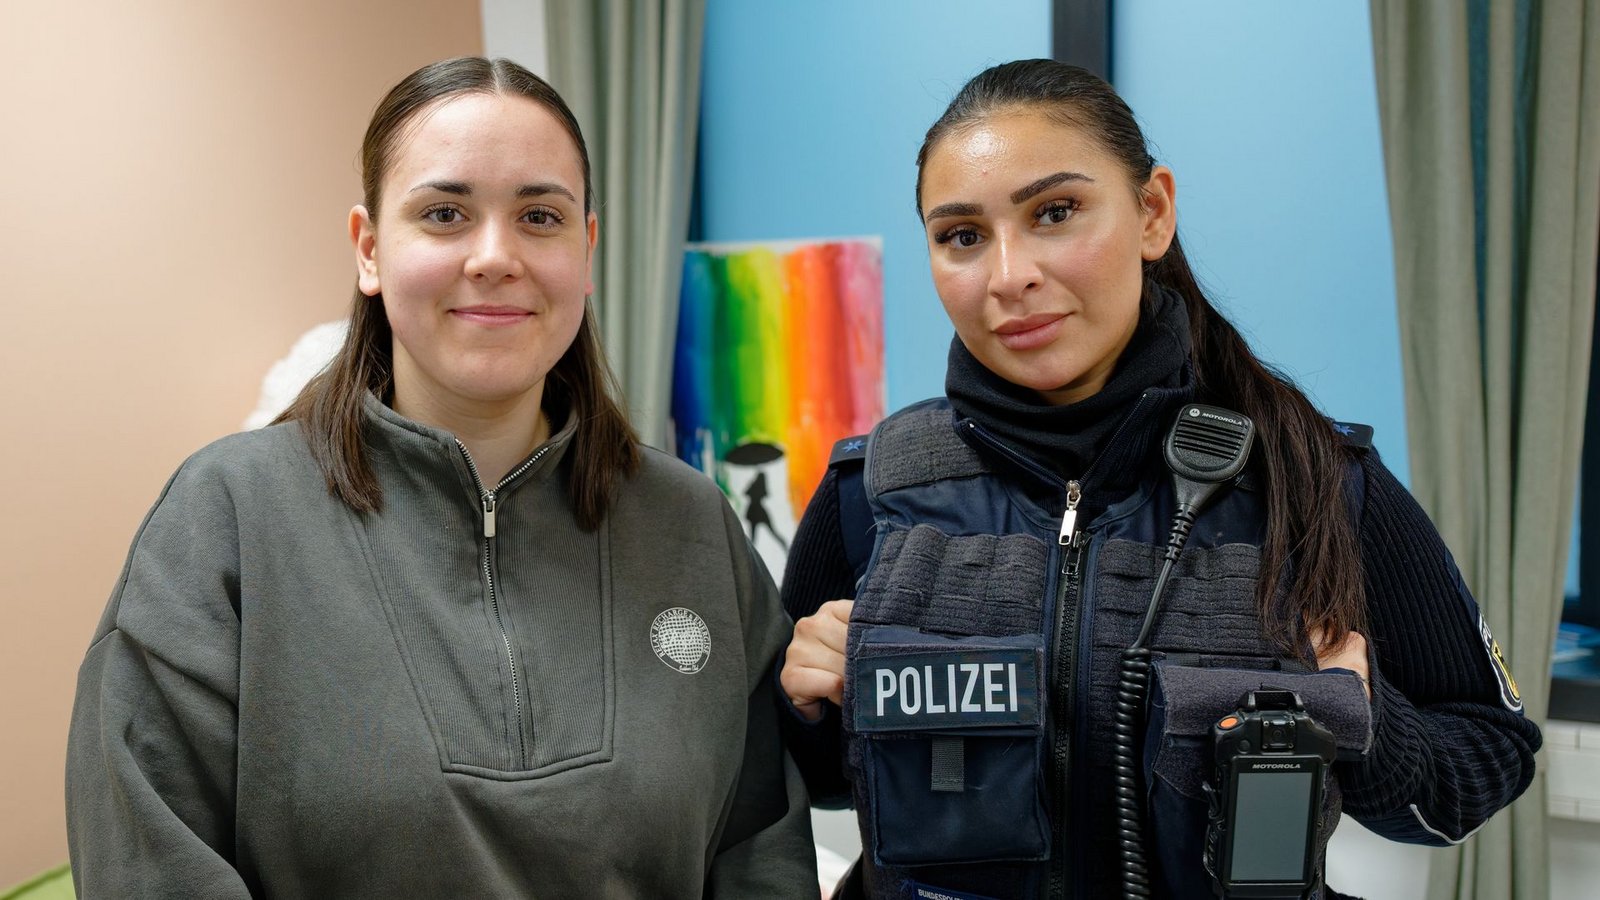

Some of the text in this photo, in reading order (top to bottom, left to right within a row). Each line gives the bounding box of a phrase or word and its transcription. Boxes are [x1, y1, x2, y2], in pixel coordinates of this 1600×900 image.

[1202, 412, 1242, 426] MOTOROLA
[653, 609, 689, 631] RECHARGE
[651, 633, 666, 658] RELAX
[875, 663, 1018, 717] POLIZEI
